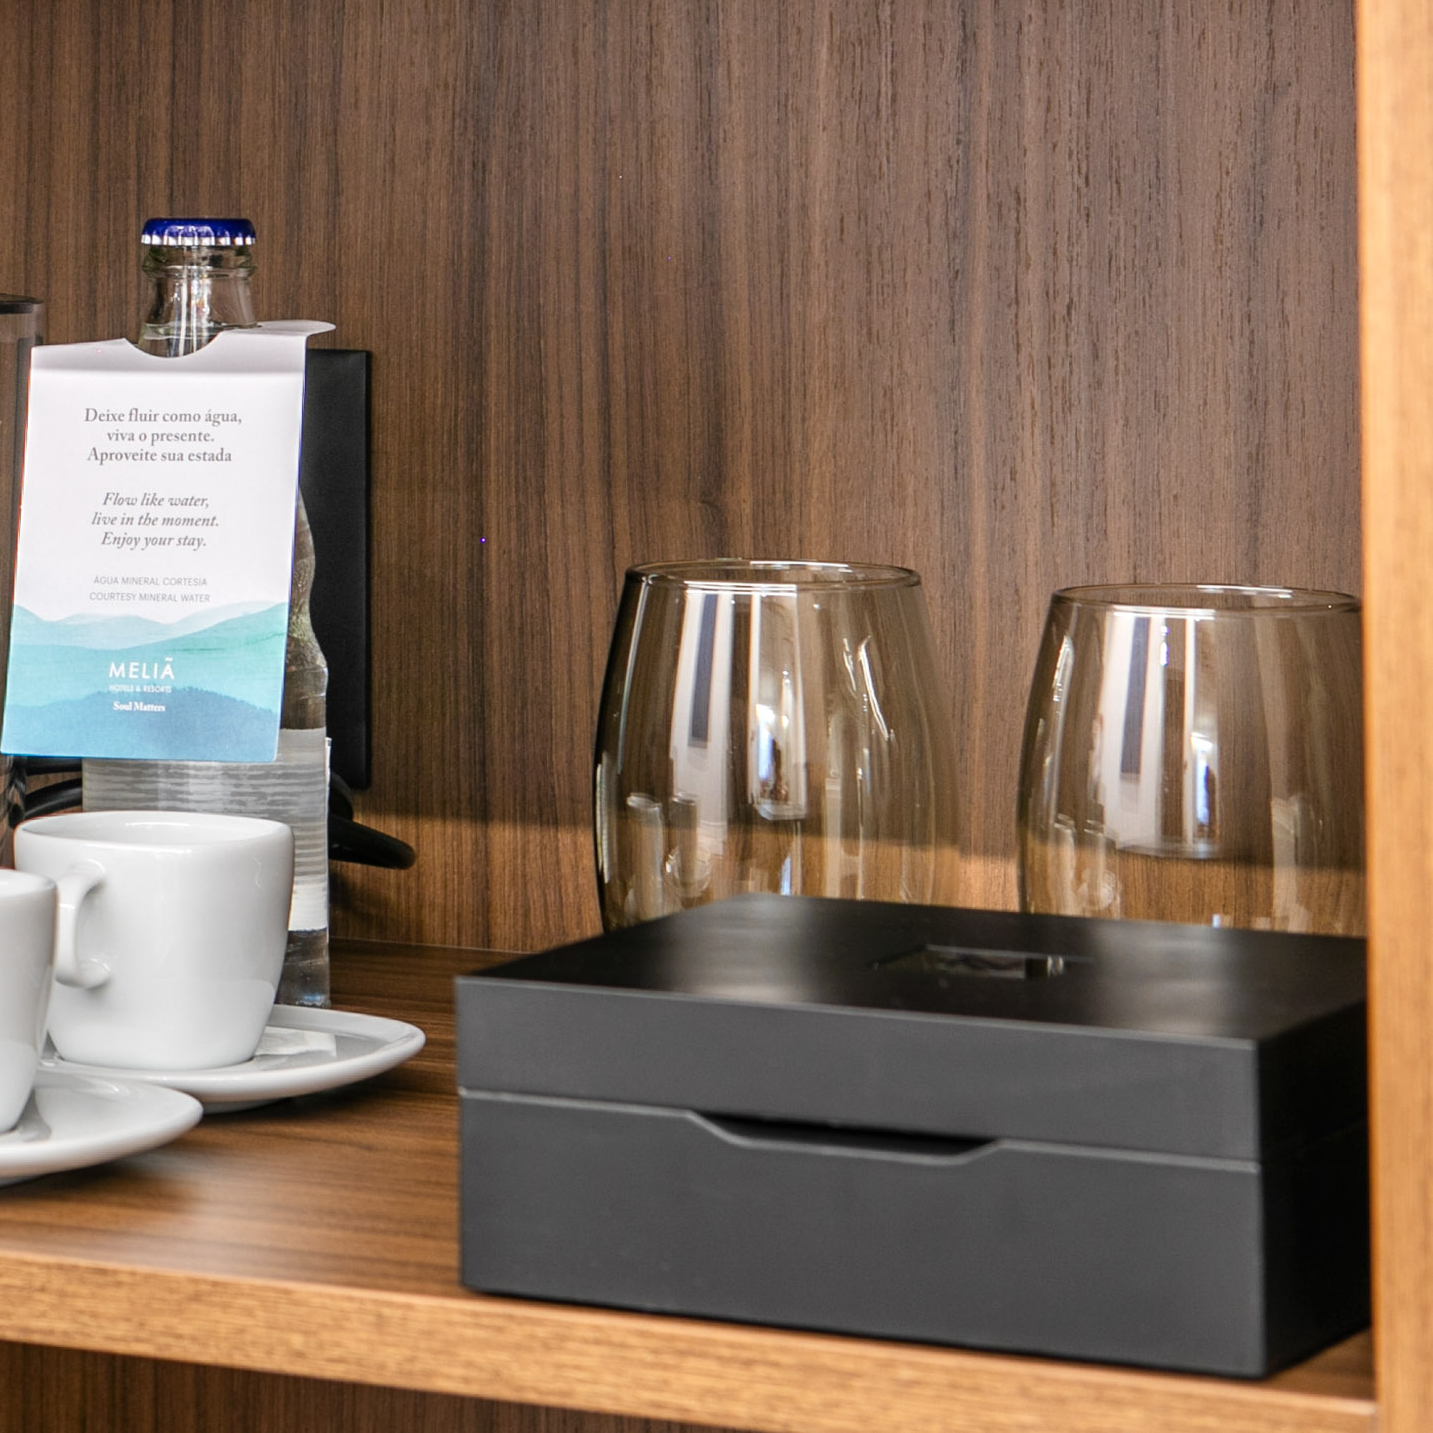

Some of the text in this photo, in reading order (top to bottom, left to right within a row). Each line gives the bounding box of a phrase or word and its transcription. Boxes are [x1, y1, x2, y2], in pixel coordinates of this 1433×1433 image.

[84, 407, 242, 427] Deixe fluir como água,
[107, 429, 215, 447] viva o presente.
[86, 447, 232, 466] Aproveite sua estada
[102, 492, 210, 509] Flow like water,
[91, 512, 220, 527] live in the moment.
[100, 531, 207, 552] Enjoy your stay.
[121, 577, 160, 586] MINERAL
[162, 577, 208, 587] CORTESIA
[89, 592, 211, 603] COURTESY MINERAL WATER
[113, 700, 166, 712] Soul Matters
